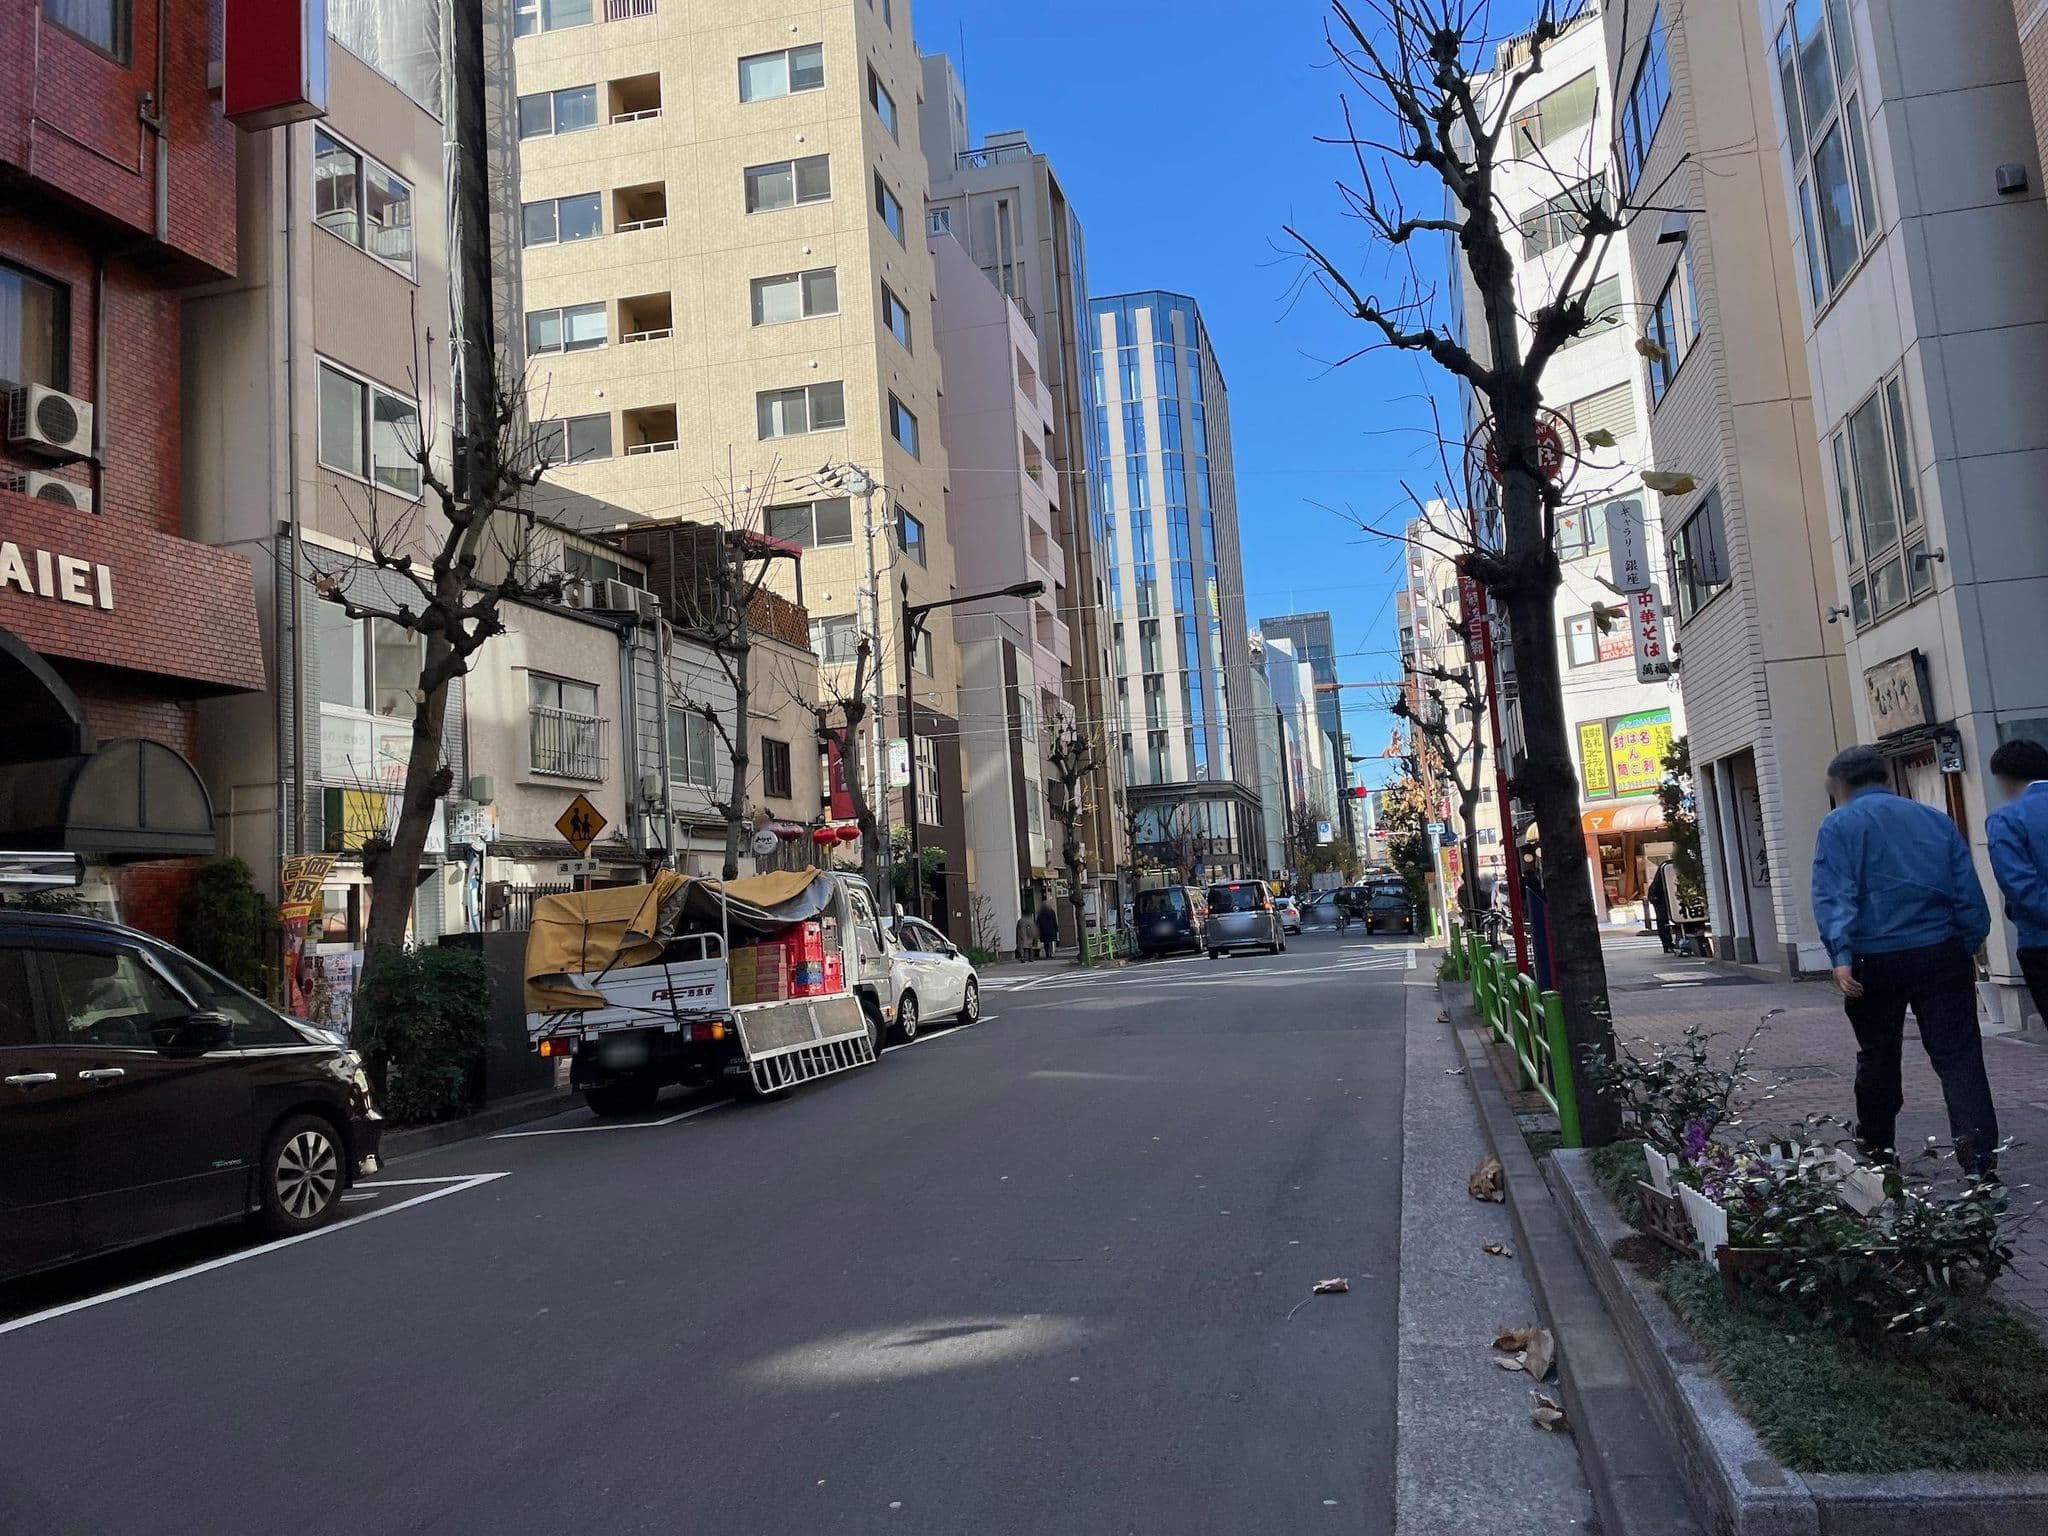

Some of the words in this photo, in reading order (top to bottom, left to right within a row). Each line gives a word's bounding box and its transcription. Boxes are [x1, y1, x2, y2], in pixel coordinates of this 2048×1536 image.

[1620, 507, 1640, 585] ギャラリー銀座
[0, 541, 114, 610] AIEI
[1627, 734, 1641, 775] はんこ
[283, 857, 333, 881] 高価
[559, 862, 597, 873] 通学路
